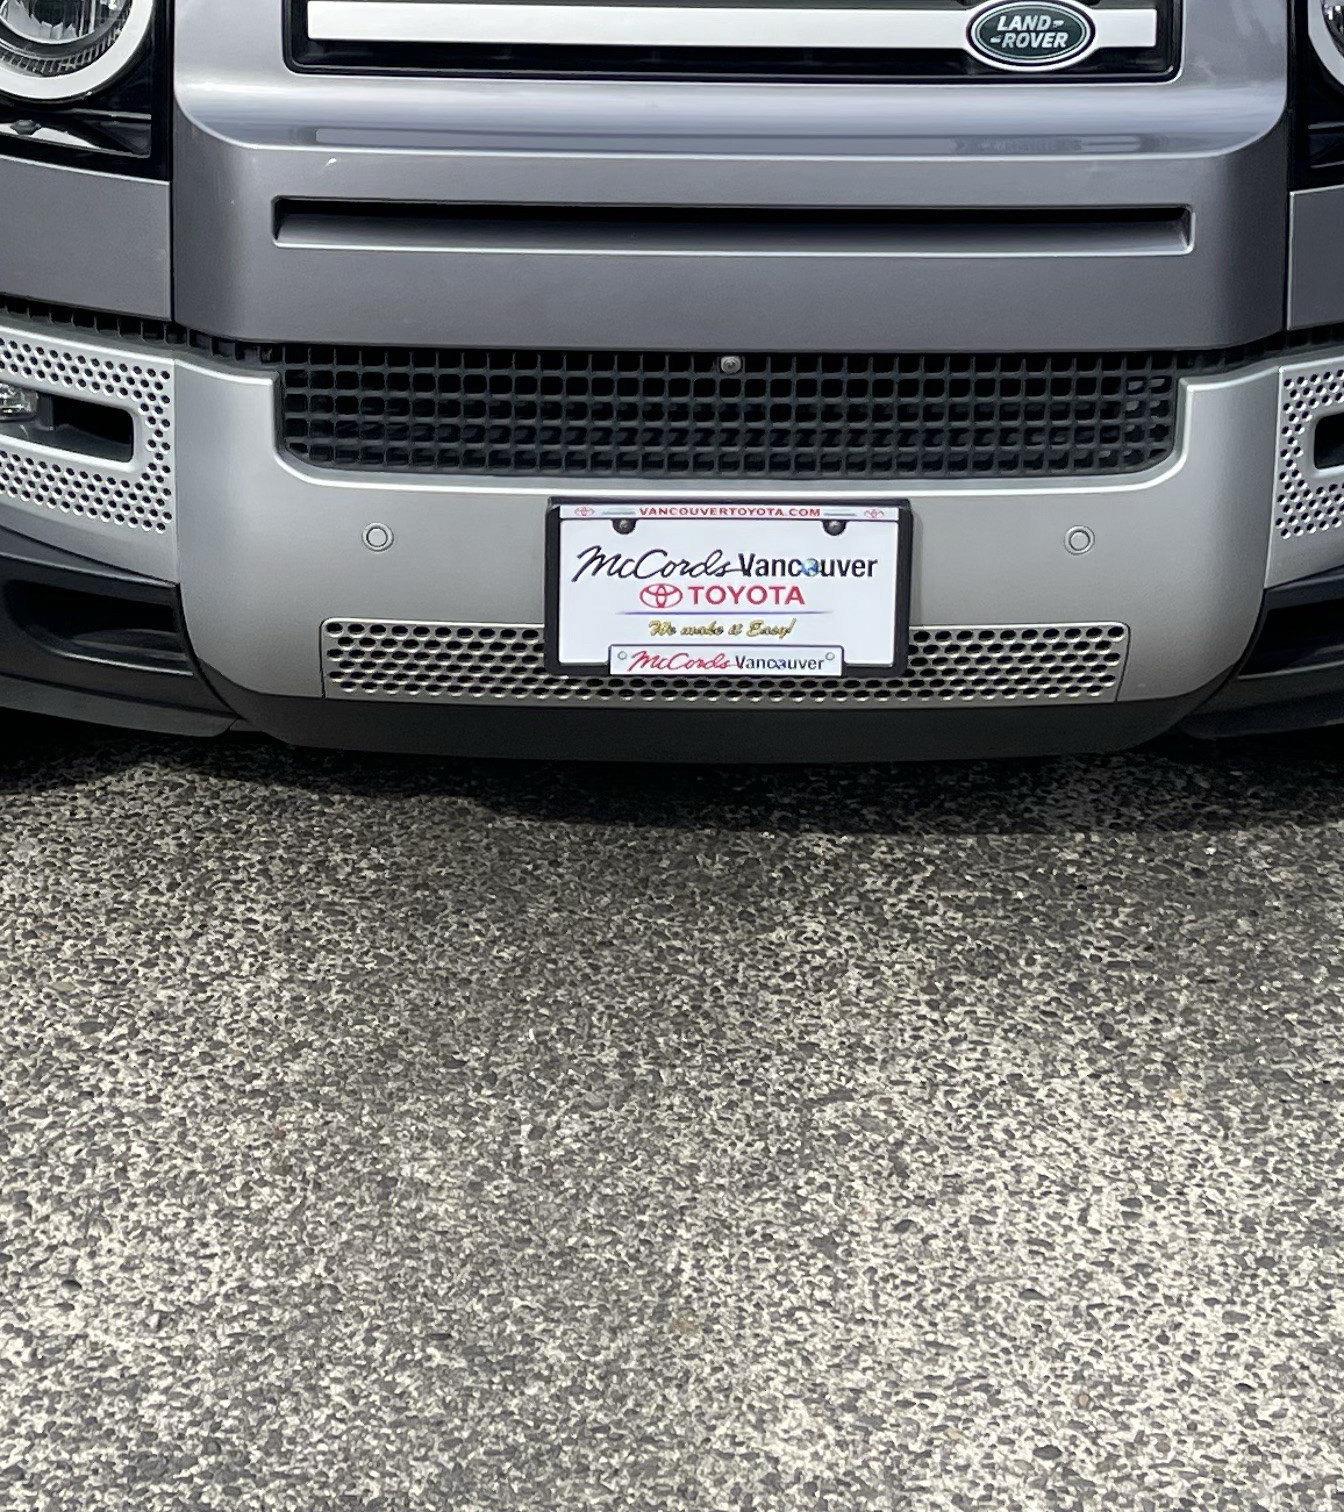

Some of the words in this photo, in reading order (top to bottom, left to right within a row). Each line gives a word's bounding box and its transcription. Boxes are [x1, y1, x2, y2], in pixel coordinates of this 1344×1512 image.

[639, 506, 821, 518] VANCOUVERTOYOTA.COM
[688, 585, 806, 606] TOYOTA
[647, 618, 676, 637] We
[679, 620, 724, 637] make
